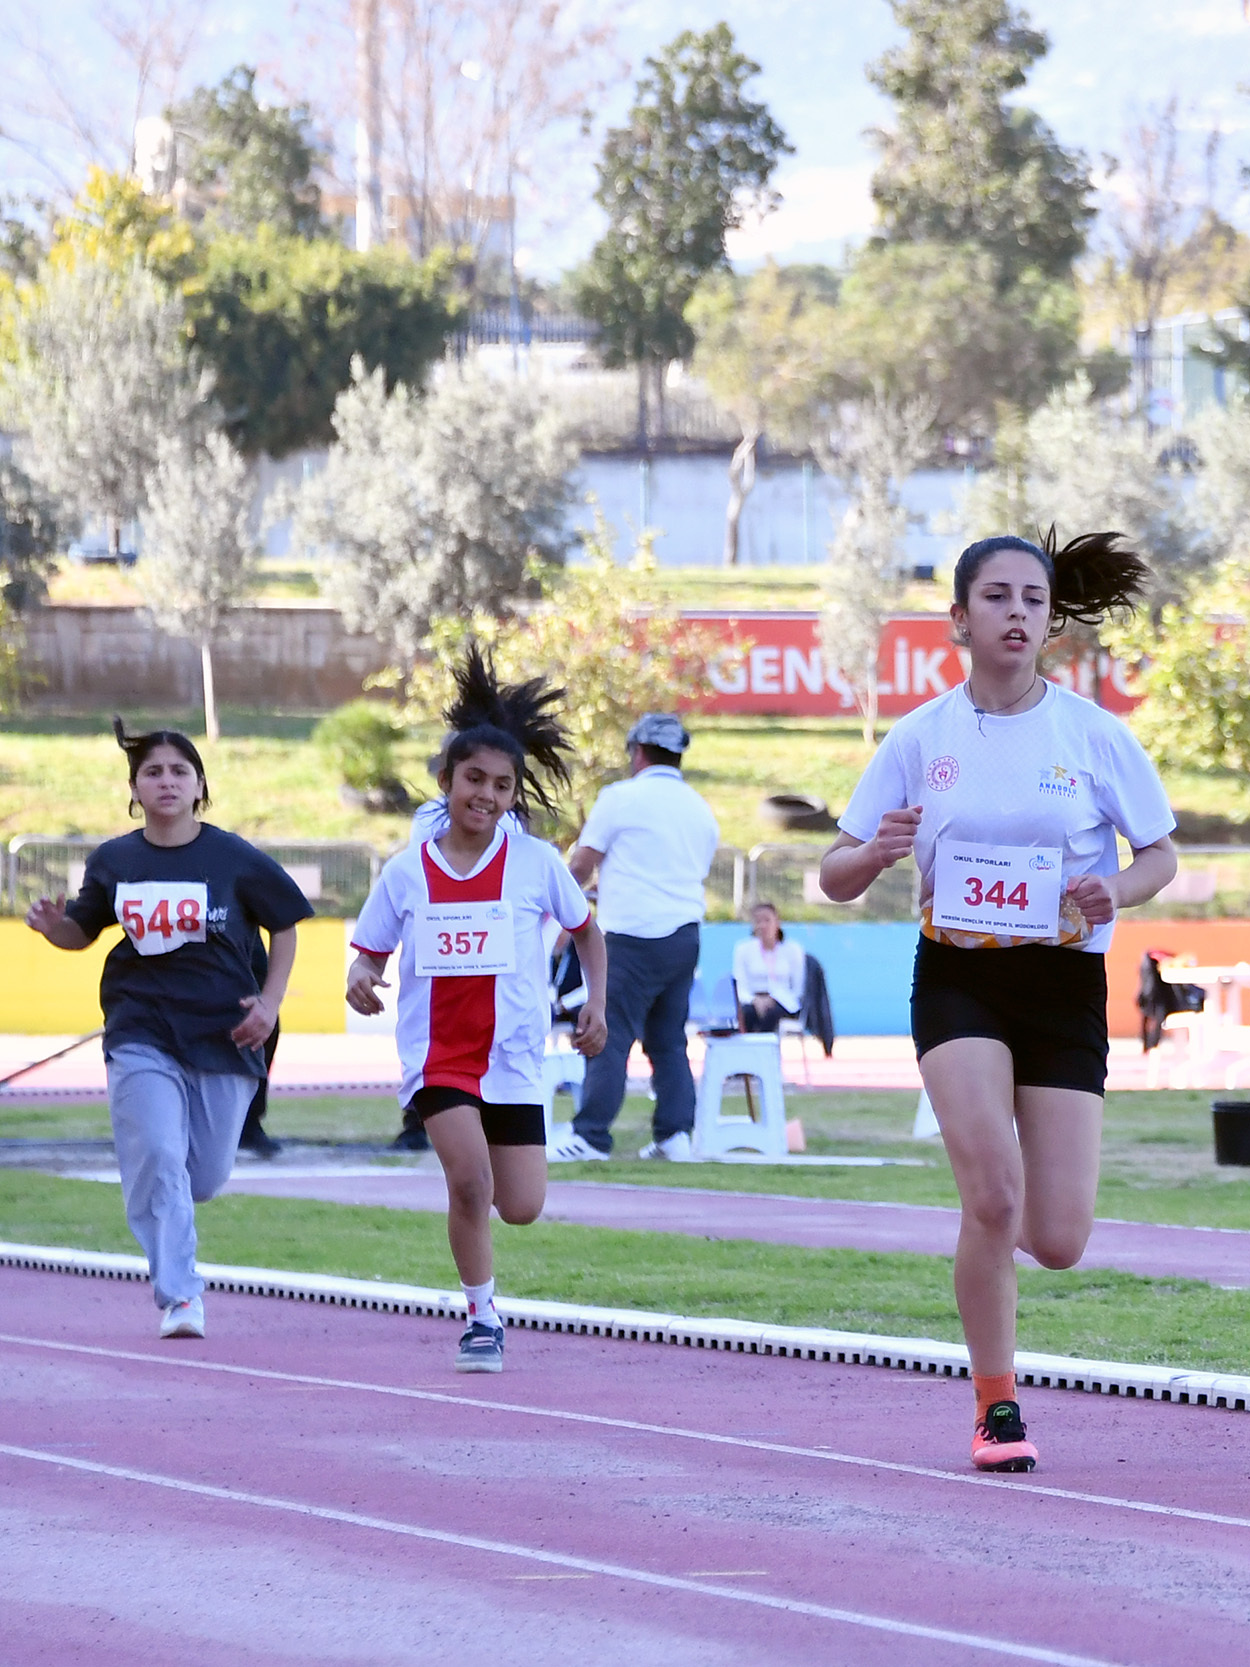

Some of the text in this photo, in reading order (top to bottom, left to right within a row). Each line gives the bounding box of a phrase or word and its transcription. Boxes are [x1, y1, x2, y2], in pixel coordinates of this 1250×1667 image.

[1039, 782, 1077, 795] ANADOLU
[953, 855, 1011, 867] OKUL SPORLARI
[963, 876, 1029, 911] 344
[122, 899, 200, 941] 548
[437, 931, 489, 956] 357
